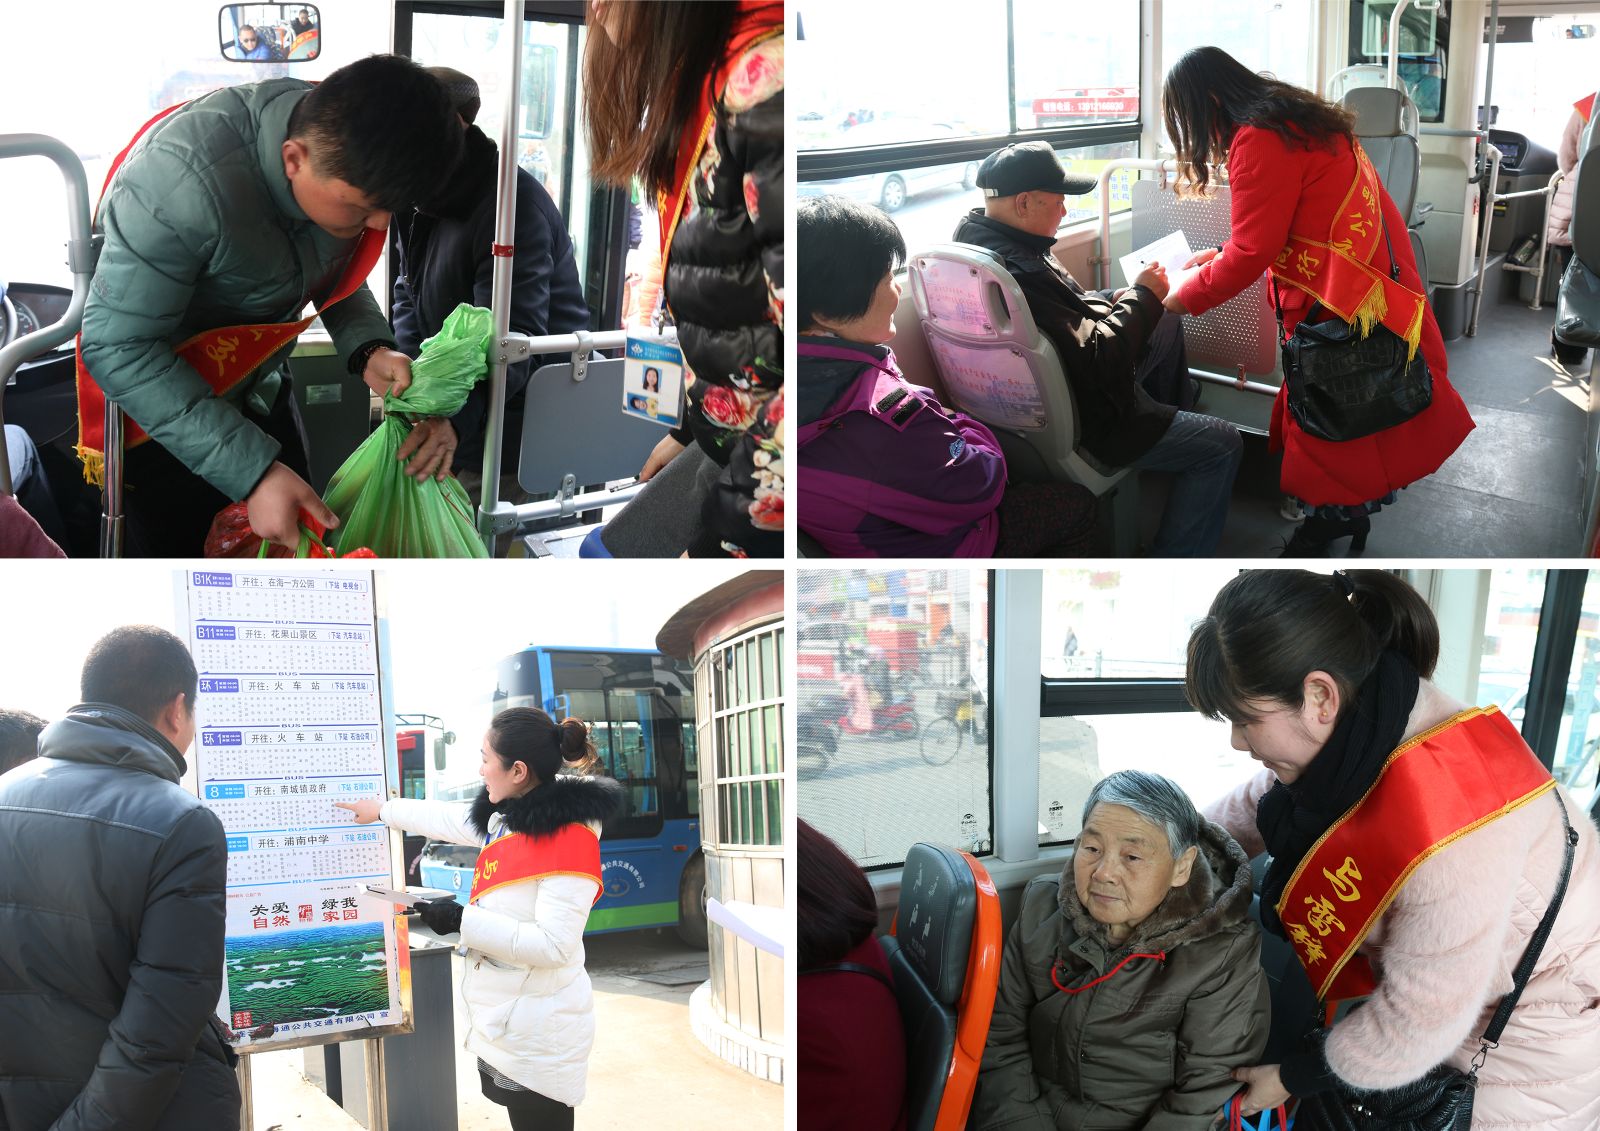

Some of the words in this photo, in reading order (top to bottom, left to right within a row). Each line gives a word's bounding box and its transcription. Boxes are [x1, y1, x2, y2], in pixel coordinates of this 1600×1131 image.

[194, 573, 212, 586] B1K
[198, 627, 216, 639] B11
[200, 679, 212, 691] 环
[203, 732, 215, 745] 环
[211, 786, 220, 798] 8
[249, 901, 290, 917] 关爱
[321, 896, 358, 910] 绿我
[322, 909, 358, 922] 家园
[253, 915, 291, 930] 自然
